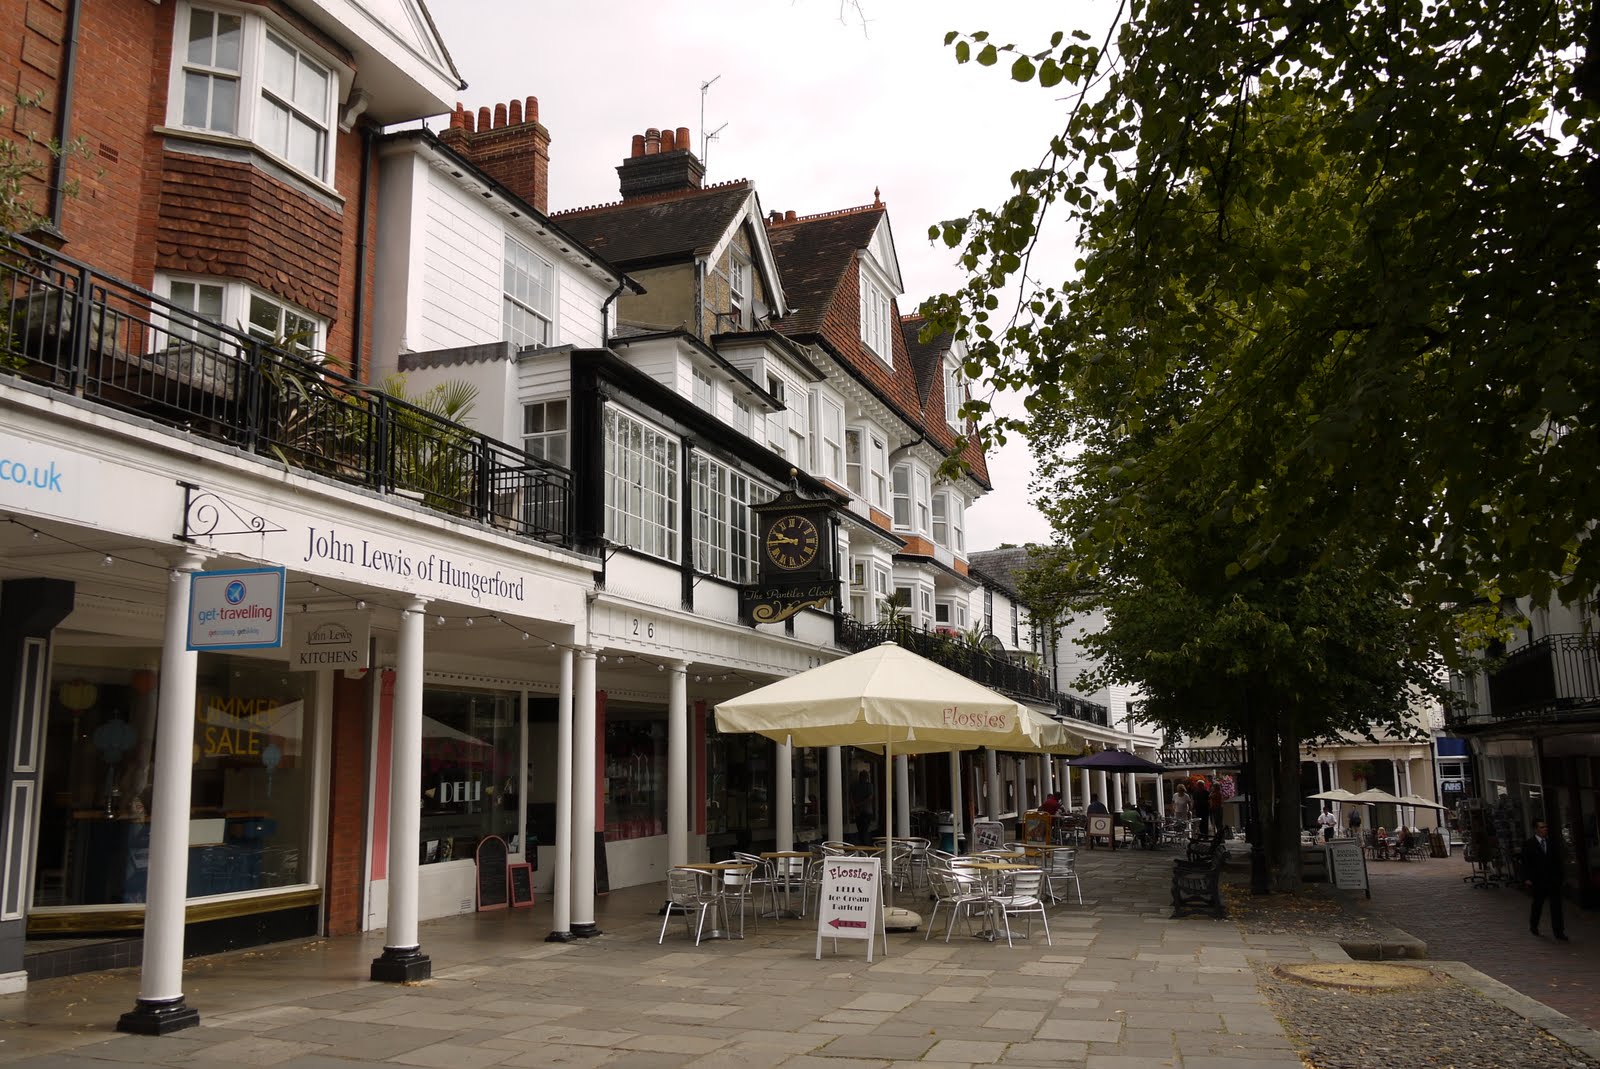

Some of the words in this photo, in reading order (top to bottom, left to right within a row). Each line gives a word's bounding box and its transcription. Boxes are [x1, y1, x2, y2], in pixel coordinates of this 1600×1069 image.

[303, 526, 354, 564] John
[361, 540, 412, 577] Lewis
[417, 554, 435, 581] of
[438, 559, 524, 601] Hungerford
[744, 590, 763, 601] The
[766, 587, 805, 599] Pantiles
[808, 585, 834, 597] Clock
[198, 604, 272, 625] get-travelling
[305, 631, 326, 645] John
[329, 630, 353, 640] Lewis
[300, 650, 358, 664] KITCHENS
[197, 694, 280, 727] UMMER
[942, 706, 1007, 729] Flossies
[204, 726, 259, 755] SALE
[440, 781, 481, 803] DELI
[1444, 782, 1461, 791] NHS
[828, 865, 873, 882] Flossies
[832, 903, 864, 912] Parlour
[843, 895, 870, 903] Cream
